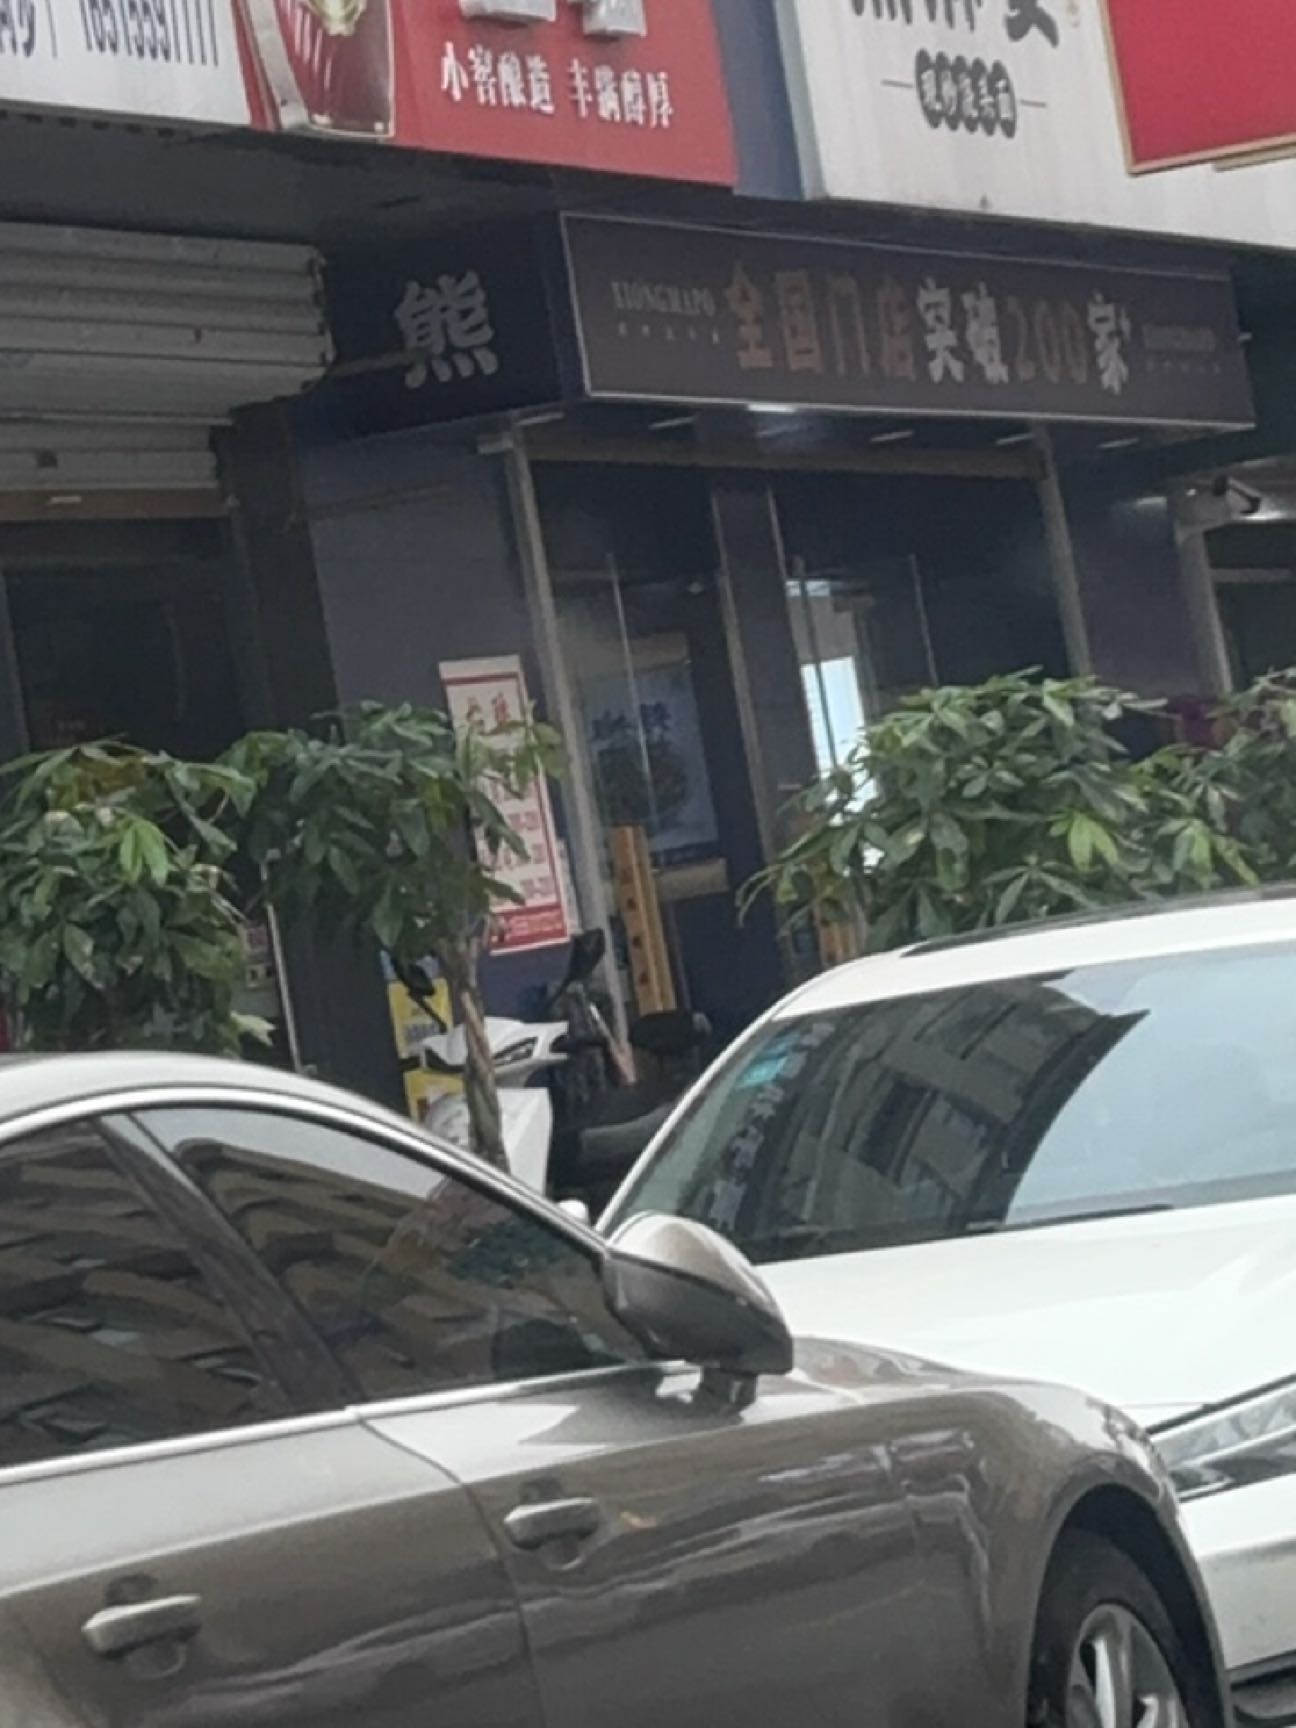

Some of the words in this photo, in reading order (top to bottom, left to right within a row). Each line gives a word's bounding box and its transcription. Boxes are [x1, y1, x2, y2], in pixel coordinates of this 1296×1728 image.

[393, 269, 499, 390] 熊
[724, 258, 1132, 396] 全国门店突破200家
